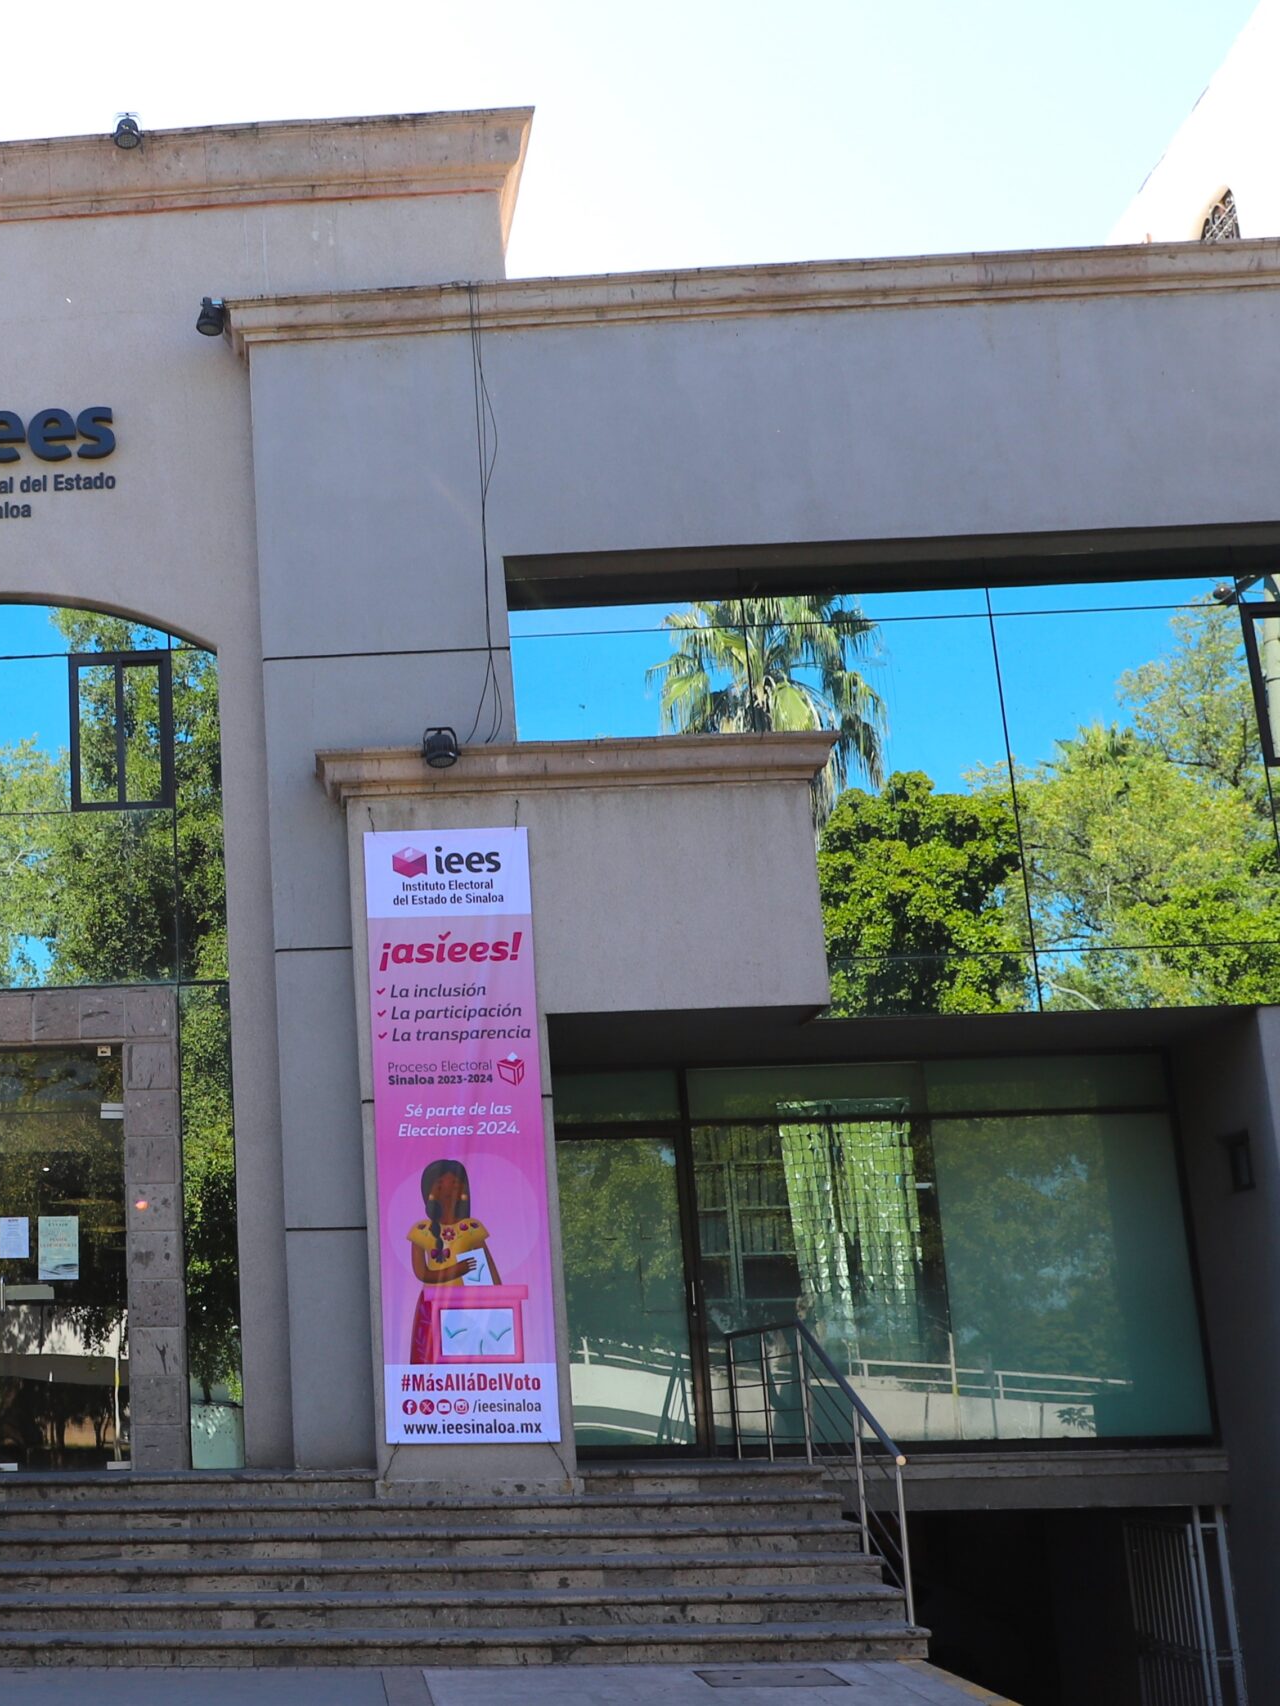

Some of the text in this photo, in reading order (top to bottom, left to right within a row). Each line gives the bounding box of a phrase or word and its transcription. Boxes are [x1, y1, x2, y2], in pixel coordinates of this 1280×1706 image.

[20, 475, 47, 494] del
[53, 472, 116, 492] Estado
[434, 846, 502, 875] iees
[402, 878, 494, 892] Instituto Electoral
[393, 892, 504, 906] del Estado de Sinaloa
[391, 982, 486, 999] La inclusión
[391, 1003, 522, 1023] La participación
[392, 1026, 531, 1044] La transparencia
[388, 1059, 492, 1073] Proceso Electoral
[388, 1073, 493, 1085] Sinaloa 2023-2024
[405, 1102, 512, 1120] Sé parte de las
[398, 1121, 520, 1137] Elecciones 2024.
[401, 1373, 541, 1392] #MásAlláDelVoto
[473, 1399, 542, 1414] /ieesinaloa
[403, 1419, 542, 1435] www.ieesinaloa.mx
